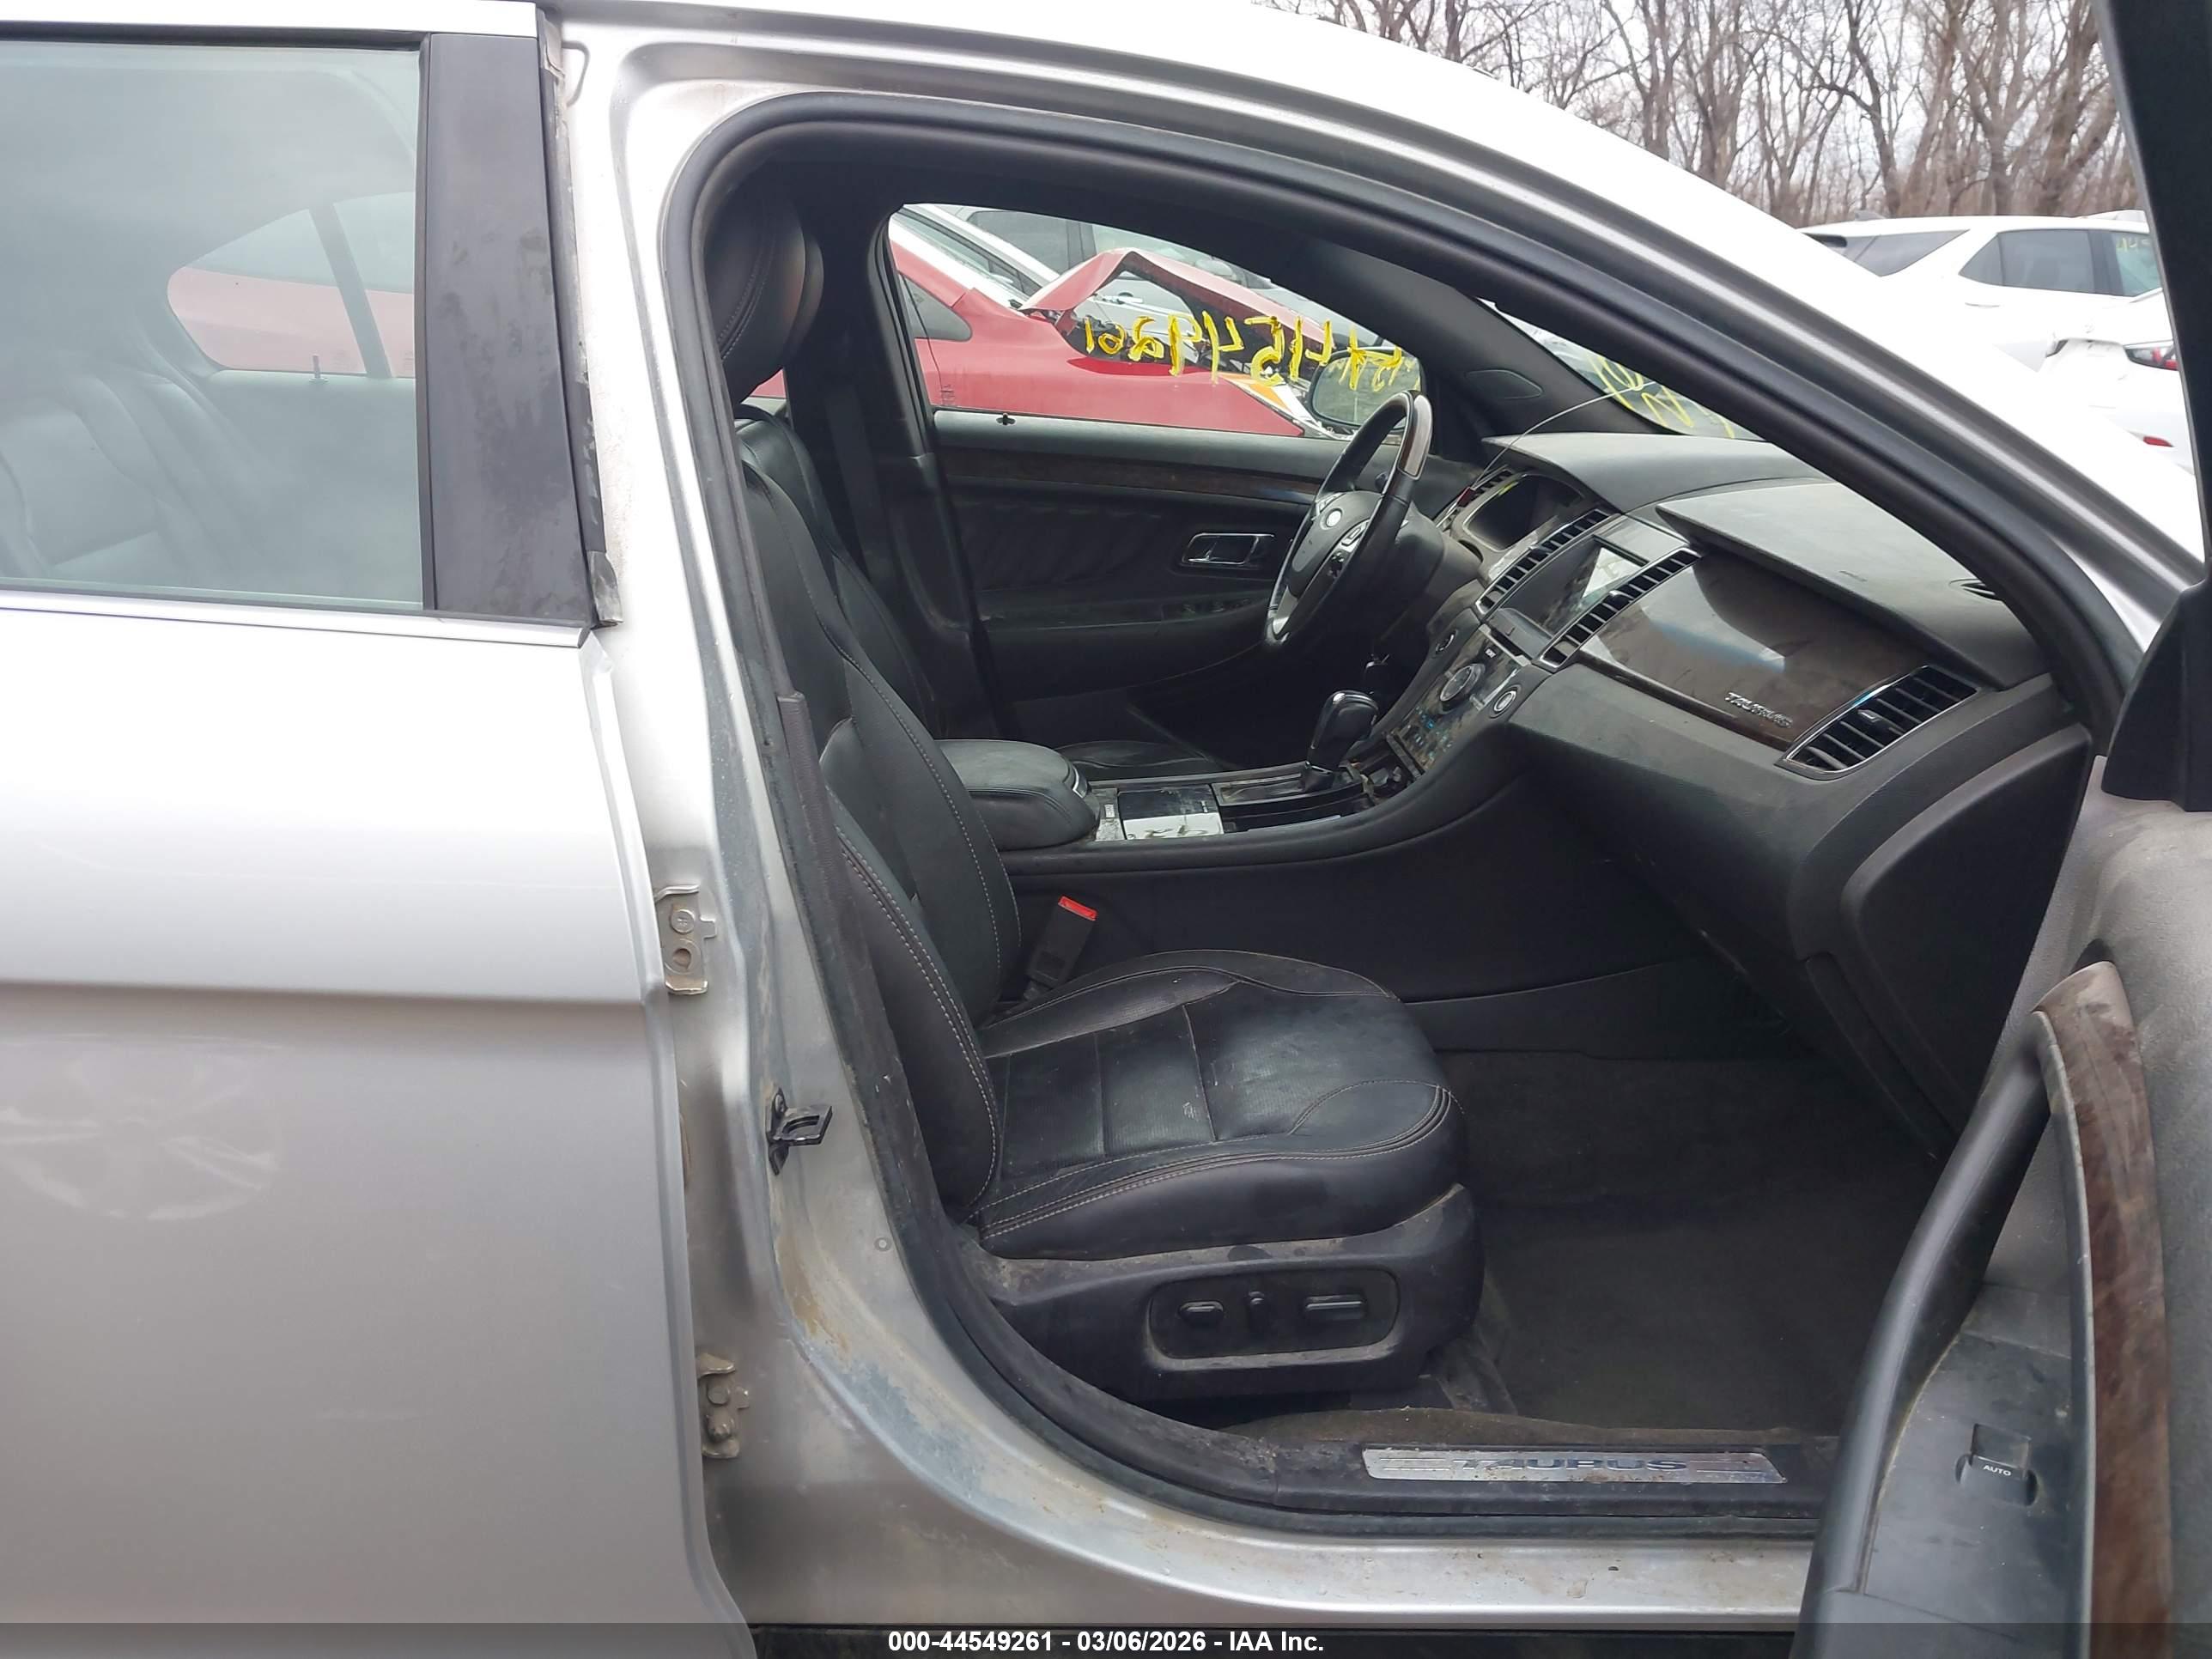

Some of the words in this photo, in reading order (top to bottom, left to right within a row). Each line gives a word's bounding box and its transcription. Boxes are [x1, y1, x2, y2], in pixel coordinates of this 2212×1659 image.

[1724, 691, 1794, 729] TAURUS
[1451, 1458, 1688, 1471] TAURUS
[1983, 1464, 2012, 1477] AUTO
